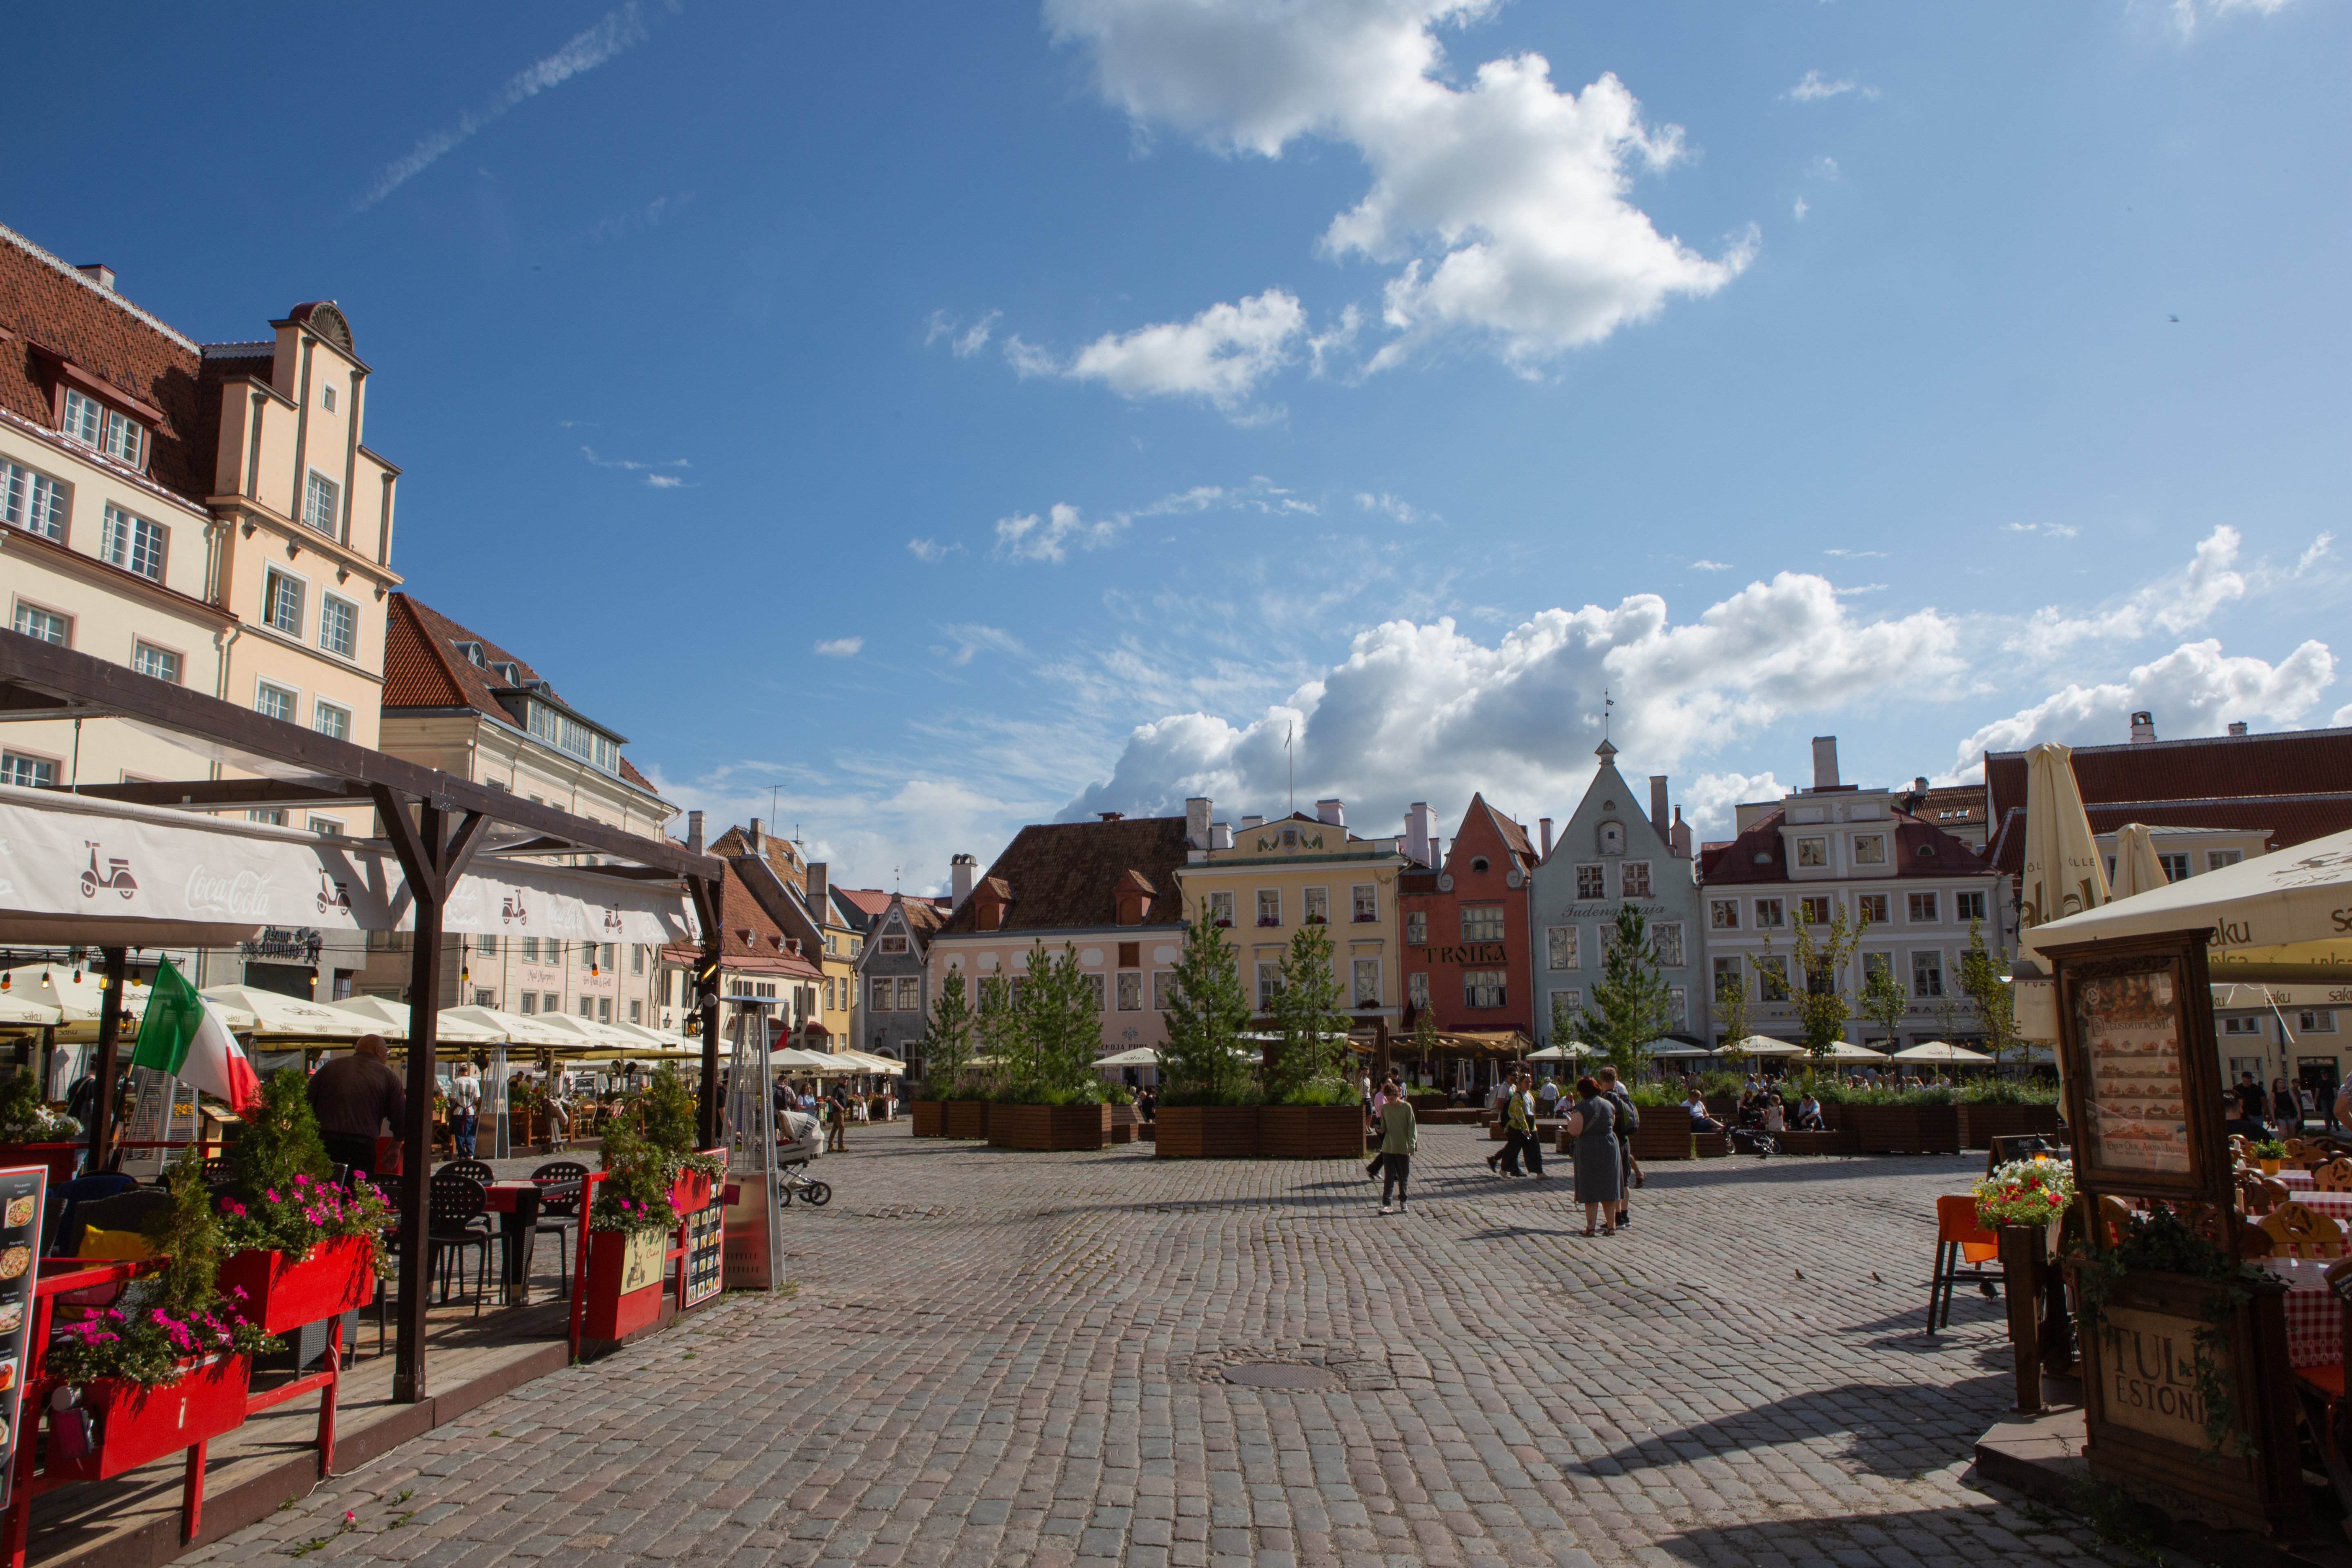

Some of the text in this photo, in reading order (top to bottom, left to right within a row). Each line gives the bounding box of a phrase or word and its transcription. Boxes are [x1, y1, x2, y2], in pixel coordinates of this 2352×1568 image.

[185, 864, 273, 915] Coca-Cola
[548, 897, 585, 930] Coca-Cola
[2206, 917, 2253, 947] aku
[1422, 944, 1507, 964] TROIKA
[528, 969, 555, 985] Mad Murphy's
[2264, 990, 2292, 1004] saku
[22, 1011, 42, 1022] saku
[225, 1013, 240, 1022] saku
[280, 1023, 294, 1031] saku
[315, 1025, 327, 1033] saku
[646, 1248, 659, 1259] Ciao
[2115, 1374, 2211, 1425] ESTONI
